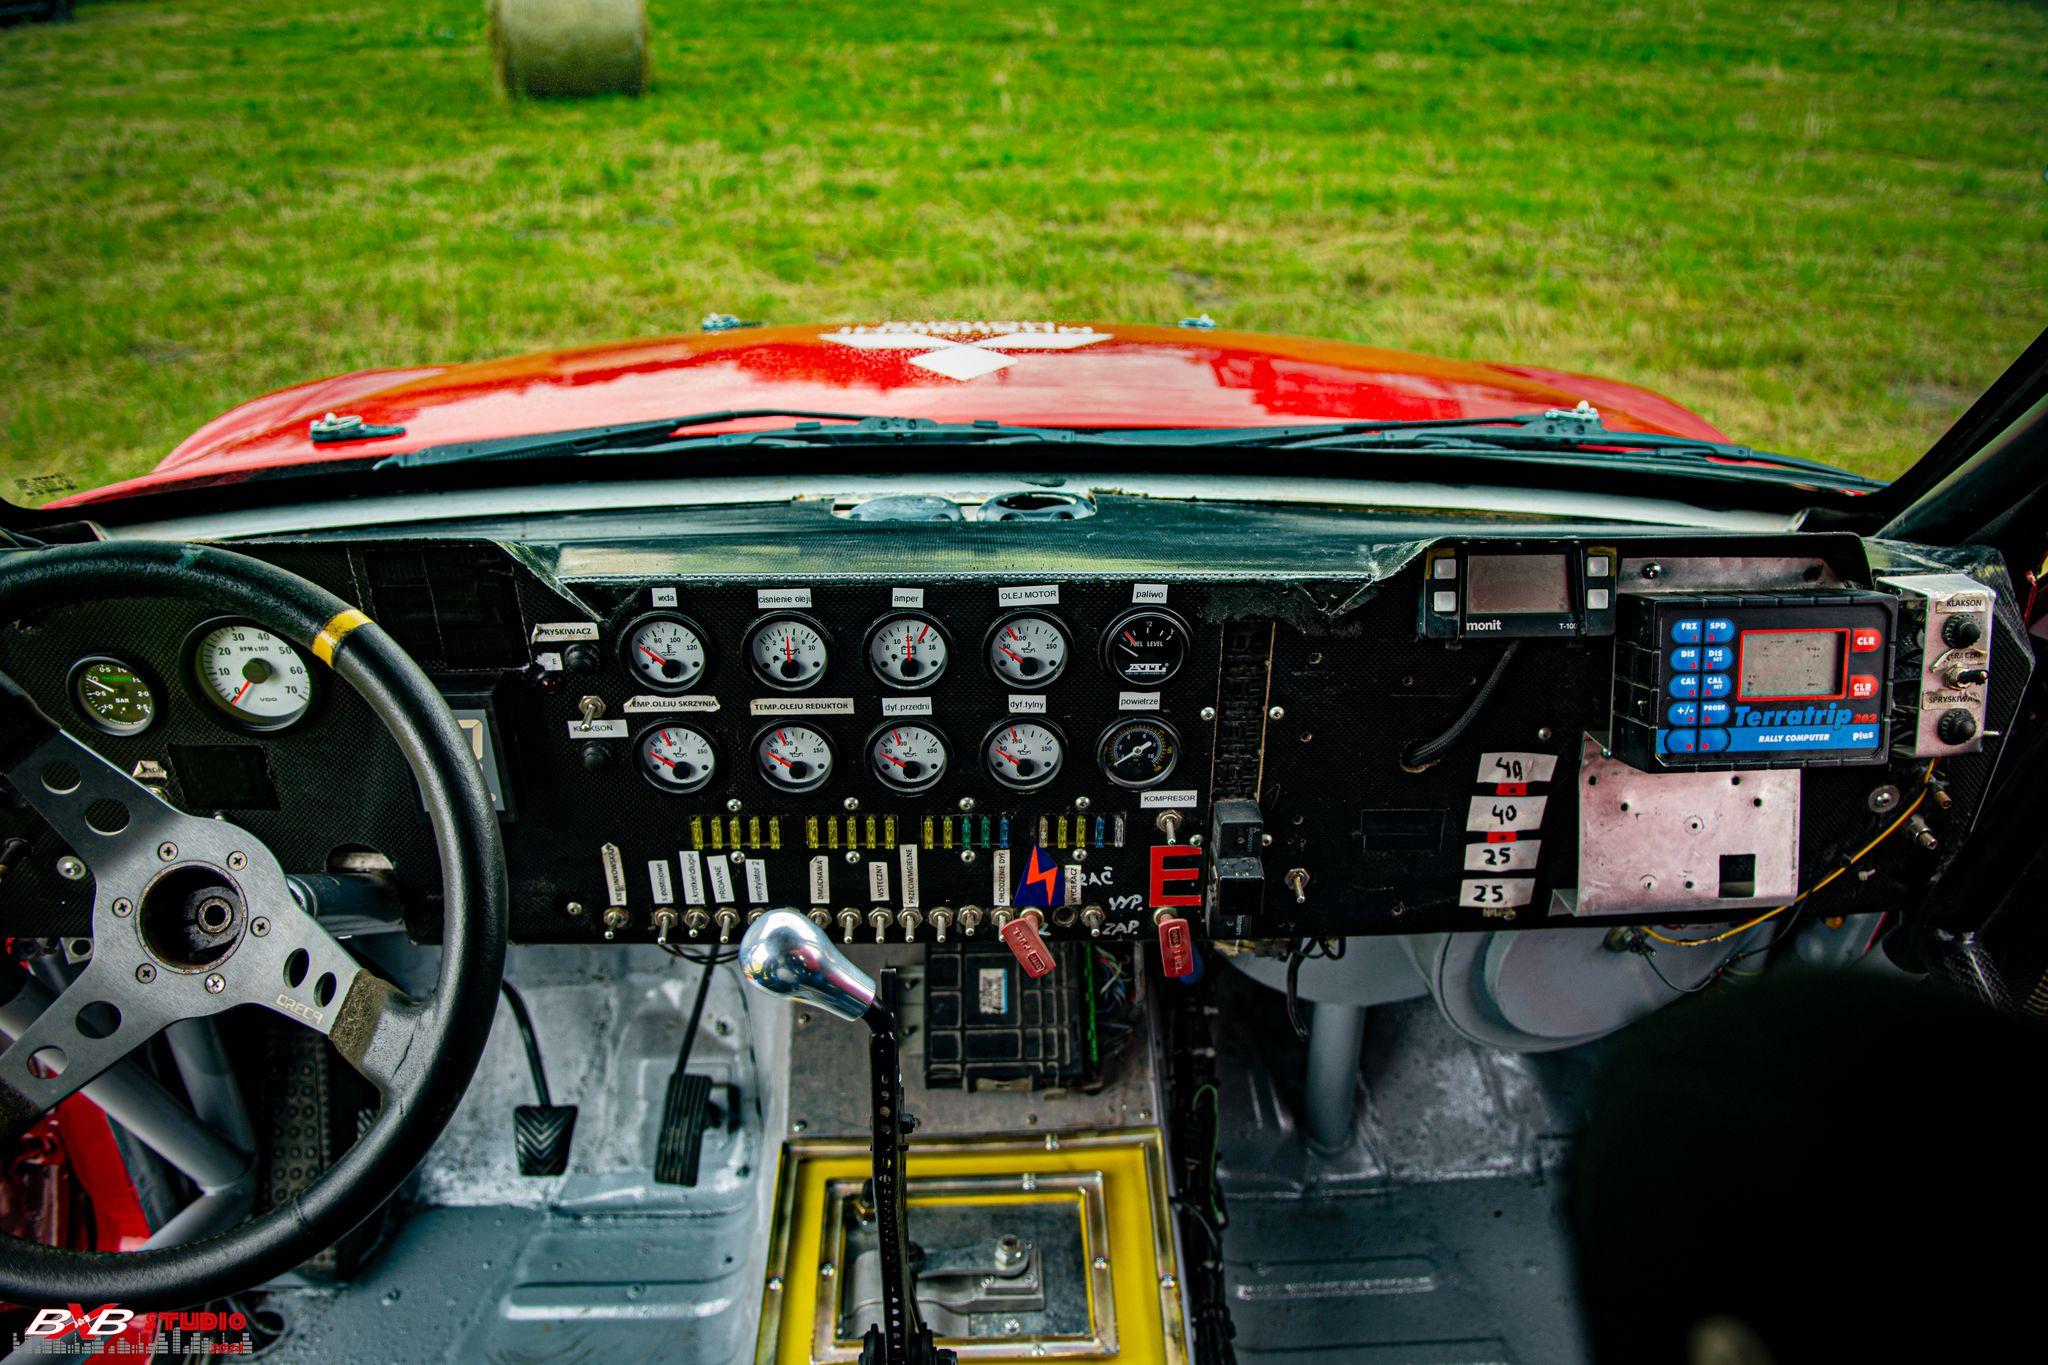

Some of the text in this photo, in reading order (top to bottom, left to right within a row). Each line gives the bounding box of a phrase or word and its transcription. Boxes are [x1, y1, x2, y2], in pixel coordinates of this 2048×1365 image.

[893, 594, 919, 604] amper
[1001, 590, 1057, 600] OLEJ MOTOR
[1136, 589, 1164, 600] paliwo
[1946, 599, 1982, 608] KLAKSON
[1466, 619, 1502, 631] monit
[1681, 622, 1697, 630] FRZ
[1710, 622, 1727, 630] SPD
[232, 633, 244, 641] 30
[257, 633, 270, 641] 40
[1856, 636, 1875, 645] CLR
[218, 647, 231, 655] 20
[278, 646, 292, 655] 50
[1681, 650, 1695, 658] DIS
[1708, 650, 1723, 658] DIS
[218, 667, 230, 675] 10
[290, 666, 302, 675] 60
[1707, 677, 1723, 685] CAL
[285, 686, 297, 694] 70
[1853, 683, 1871, 692] CLR
[678, 700, 717, 708] SKRZYNIA
[1121, 697, 1159, 708] powietrze
[1929, 695, 1979, 704] SPRYSKIWA
[755, 702, 849, 711] TEMP.OLEJU REDUKTOR
[1735, 703, 1853, 729] Terratrip
[1758, 733, 1830, 743] RALLY COMPUTER
[1853, 732, 1874, 741] plus
[1144, 794, 1196, 804] KOMPRESOR
[1492, 804, 1517, 825] 40
[1483, 847, 1511, 865] 25
[816, 859, 824, 900] DMUCHAWA
[905, 848, 915, 904] PRZECIWMGIELNE
[1149, 845, 1202, 908] E
[875, 864, 884, 898] WSTECZNY
[1473, 885, 1503, 902] 25
[1012, 927, 1032, 950] PULL
